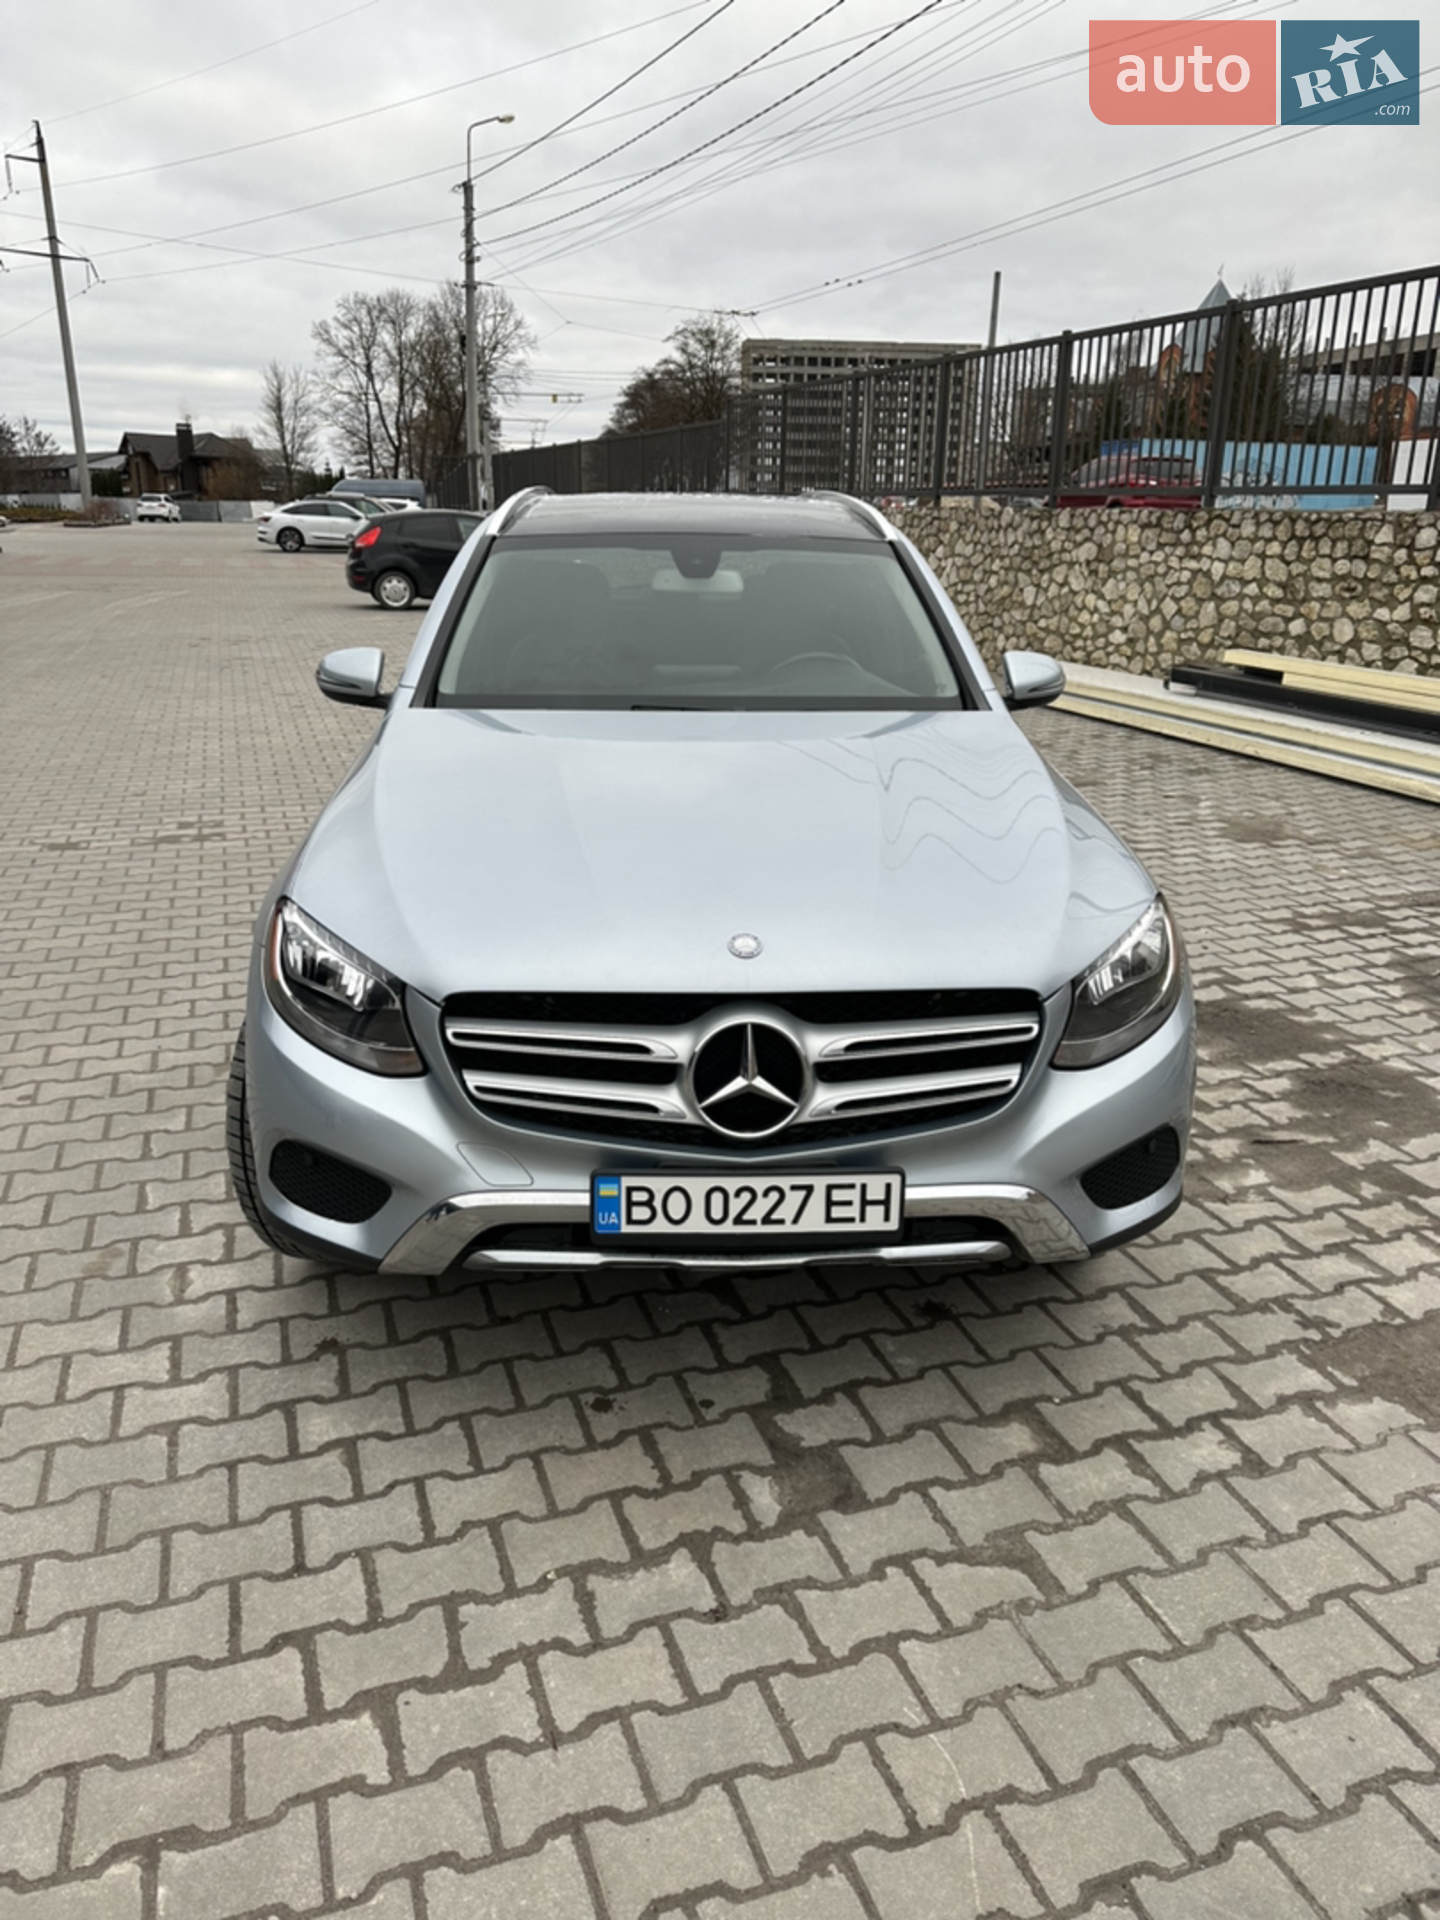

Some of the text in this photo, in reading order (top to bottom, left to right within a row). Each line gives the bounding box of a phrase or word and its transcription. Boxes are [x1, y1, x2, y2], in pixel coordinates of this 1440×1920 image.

[625, 1182, 892, 1225] BO 0227 EH
[598, 1212, 619, 1224] UA
